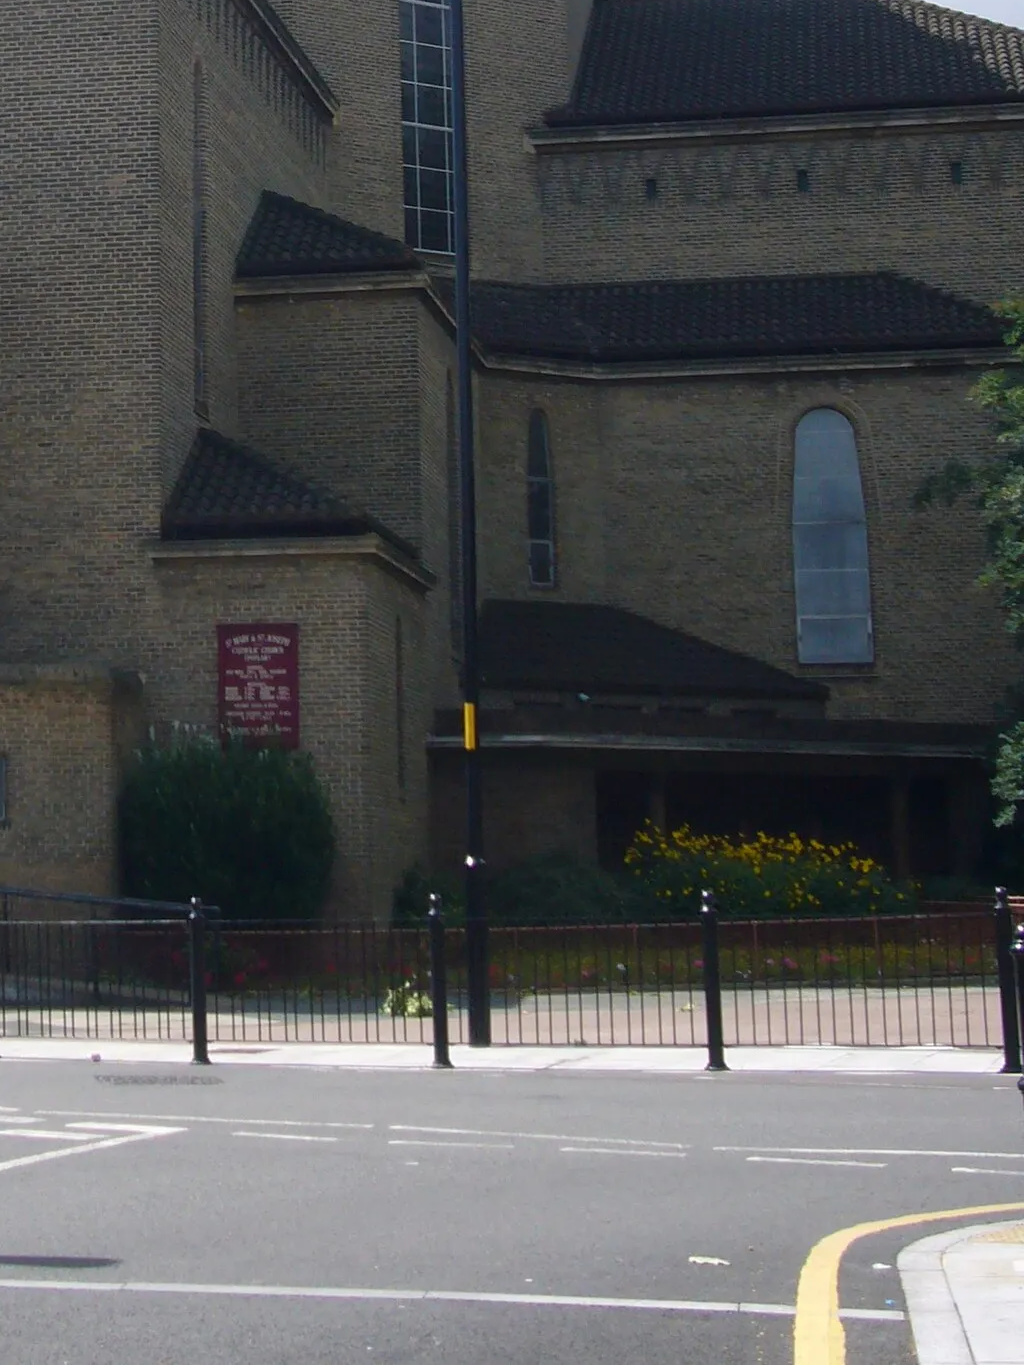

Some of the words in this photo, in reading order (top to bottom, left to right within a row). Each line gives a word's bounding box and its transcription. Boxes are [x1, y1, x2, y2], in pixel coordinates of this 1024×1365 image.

[233, 634, 249, 645] MARY
[267, 634, 291, 646] JOSEPH
[232, 646, 258, 654] CATHOLIC
[261, 646, 284, 654] CHURCH
